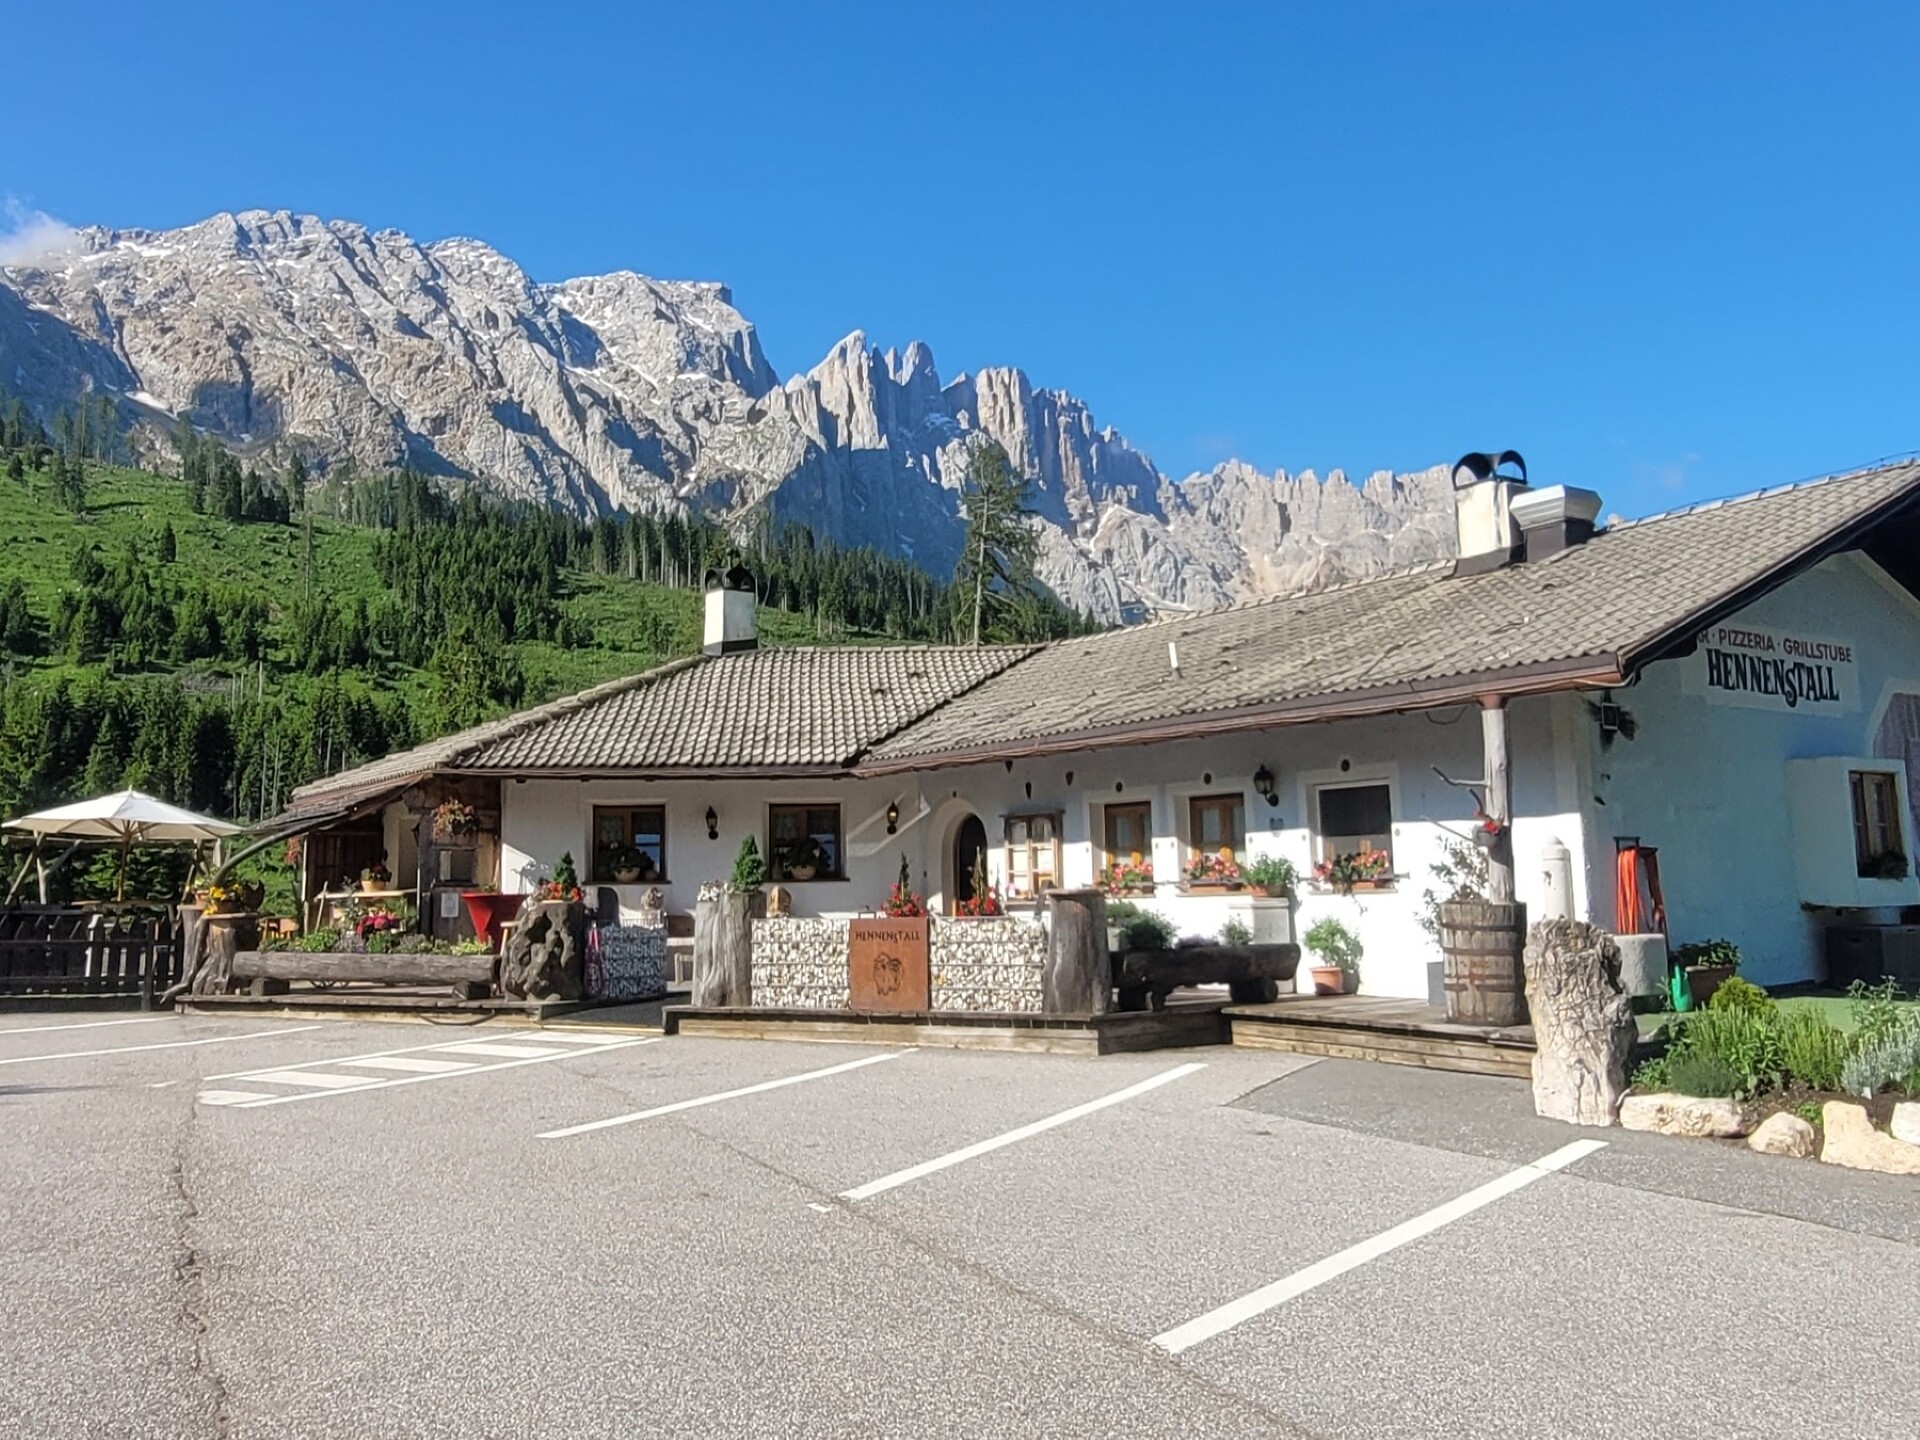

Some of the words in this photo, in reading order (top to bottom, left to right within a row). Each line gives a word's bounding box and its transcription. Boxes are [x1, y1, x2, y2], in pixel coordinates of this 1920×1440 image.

[1719, 629, 1775, 652] PIZZERIA
[1783, 638, 1852, 663] GRILLSTUBE
[1706, 649, 1840, 708] HENNENSTALL
[855, 931, 920, 943] HENNENSTALL
